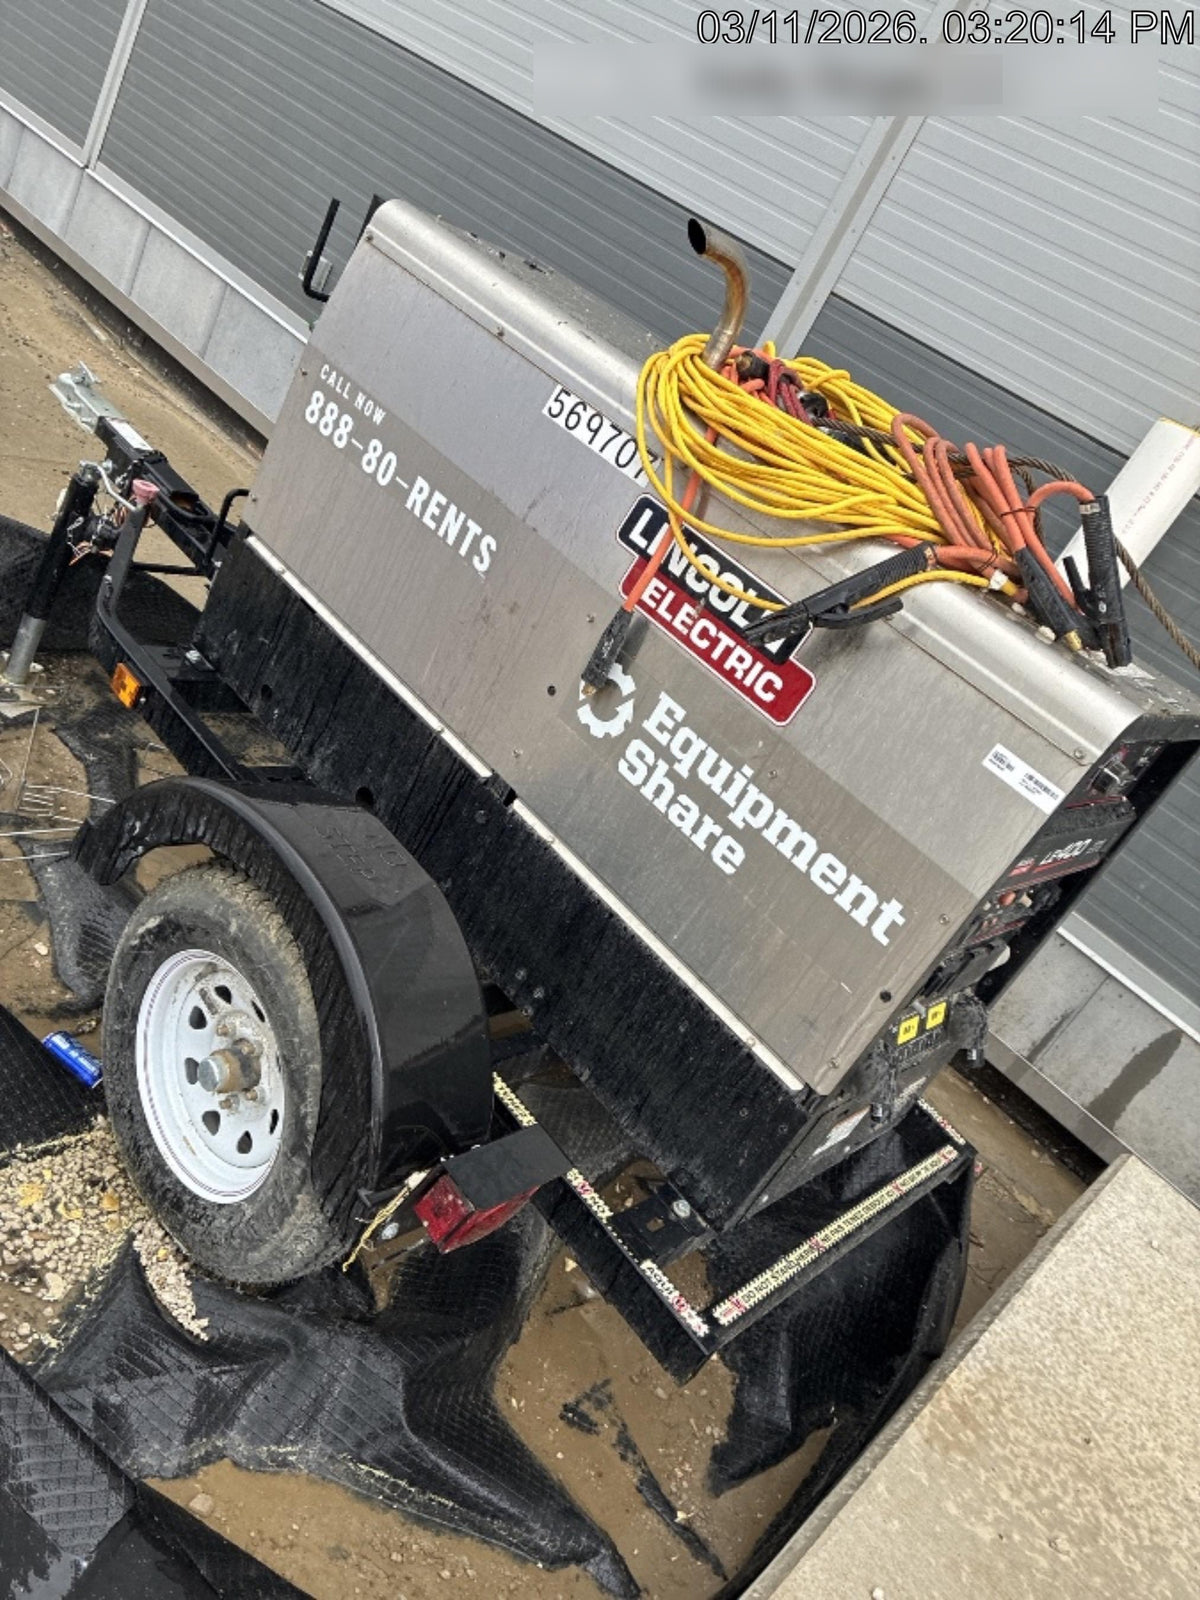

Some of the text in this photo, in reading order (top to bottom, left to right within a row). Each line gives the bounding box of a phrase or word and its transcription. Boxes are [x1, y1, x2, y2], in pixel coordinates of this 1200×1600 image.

[320, 364, 386, 426] CALL NOW
[547, 387, 659, 481] 569707
[304, 390, 498, 574] 888-80-RENTS
[641, 577, 783, 704] ELECTRIC
[617, 738, 747, 876] Share
[641, 691, 908, 947] Equipment
